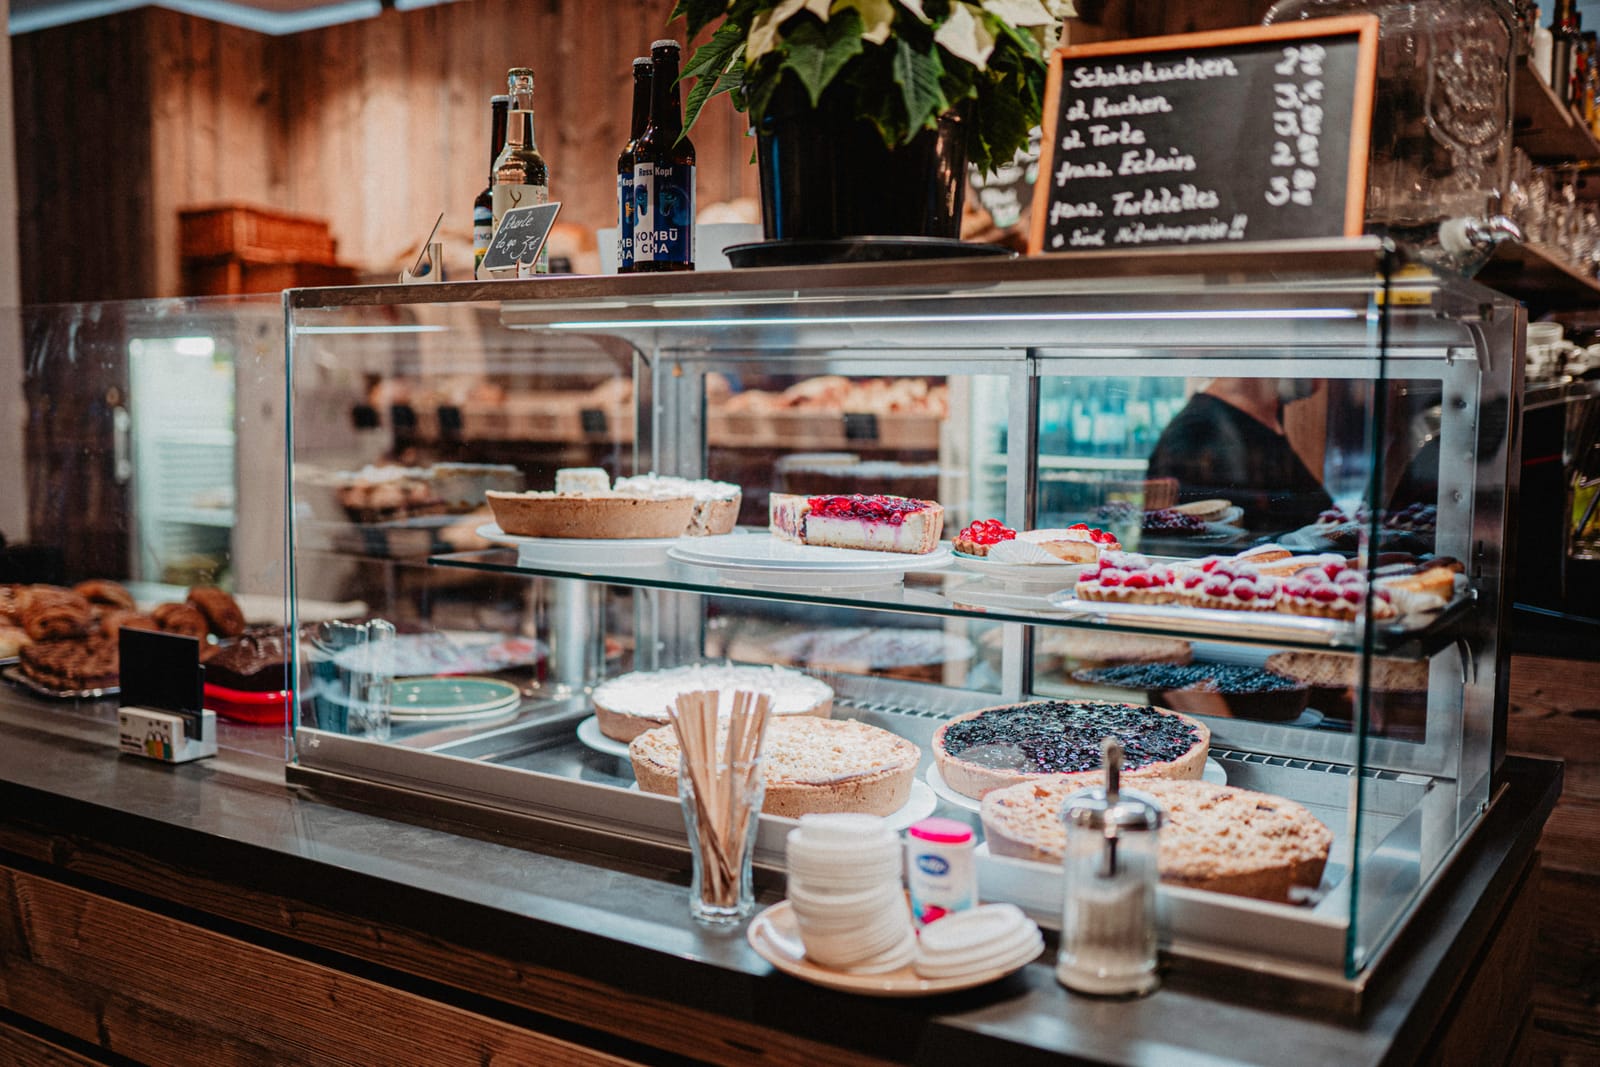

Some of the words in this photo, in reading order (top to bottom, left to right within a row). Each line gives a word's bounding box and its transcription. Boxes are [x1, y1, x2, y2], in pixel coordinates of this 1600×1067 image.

[1088, 121, 1146, 146] Torte
[1118, 147, 1197, 176] Eclairs
[654, 167, 673, 177] Kopf
[622, 178, 634, 187] Kop
[642, 243, 669, 254] CHA
